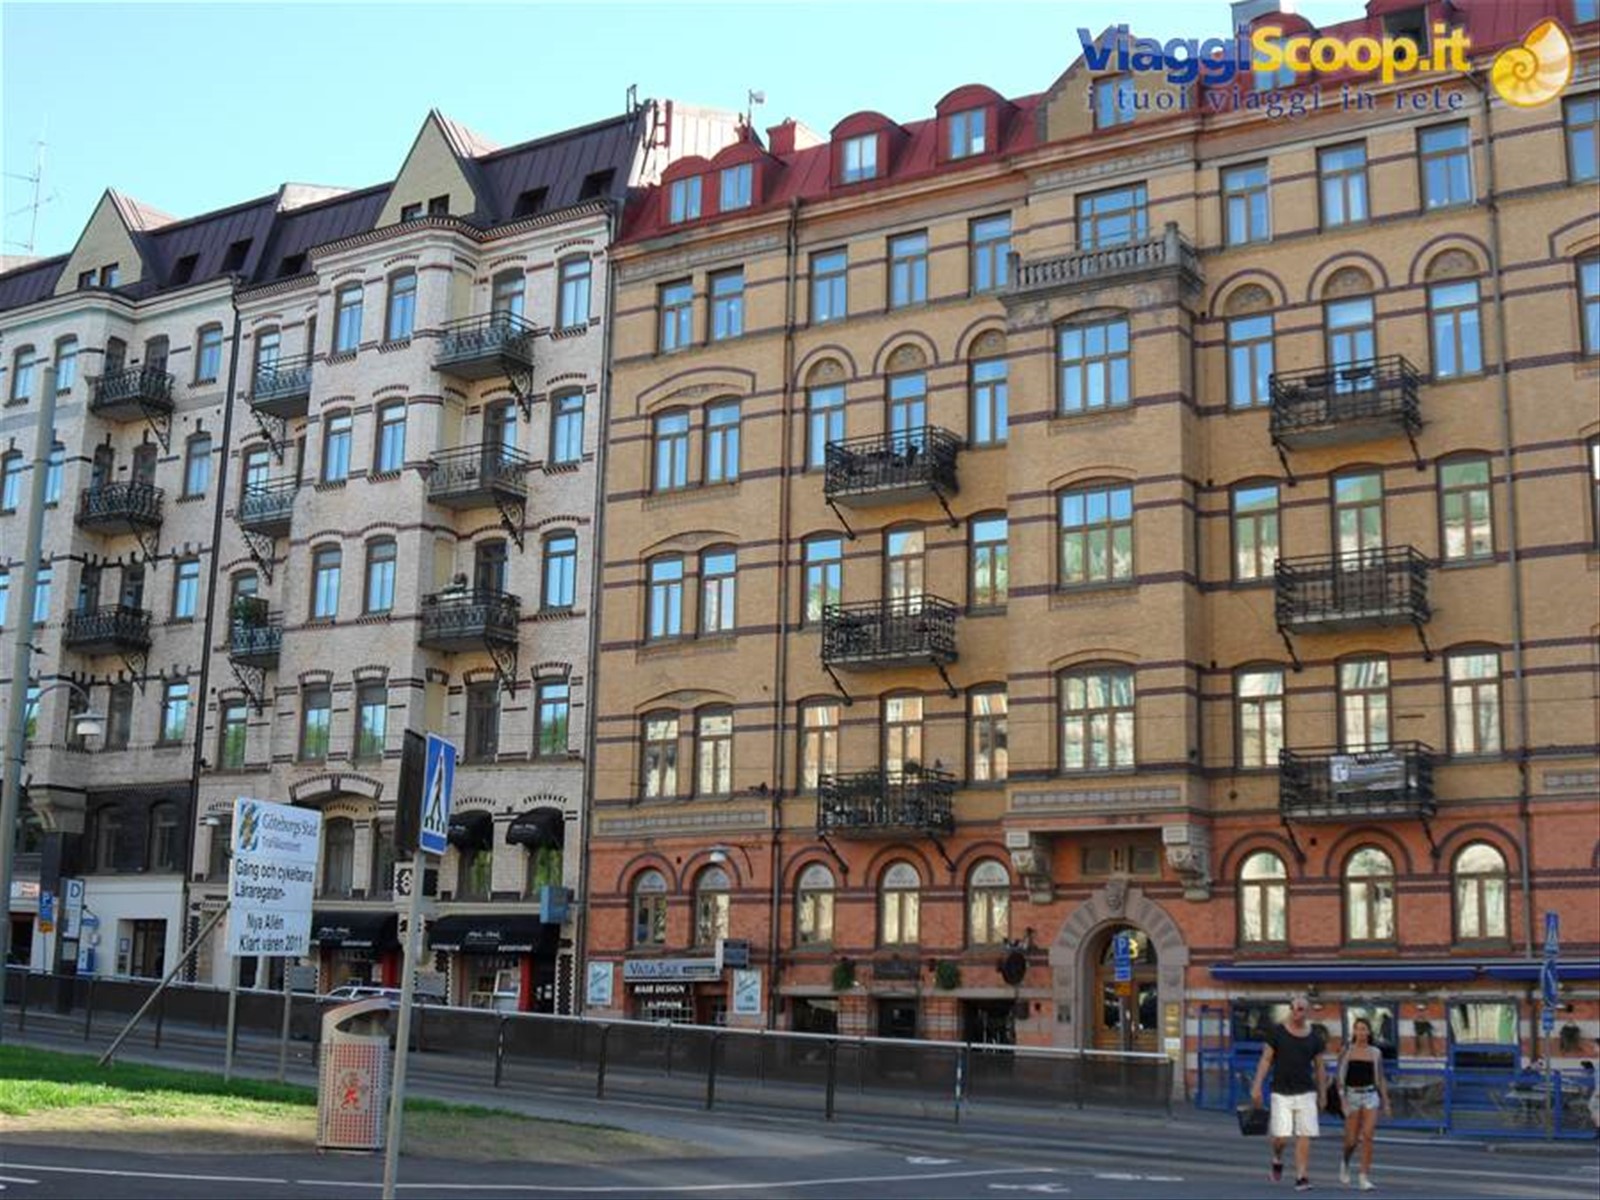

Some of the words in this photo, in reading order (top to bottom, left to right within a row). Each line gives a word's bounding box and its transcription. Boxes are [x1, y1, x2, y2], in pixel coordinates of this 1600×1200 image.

[235, 858, 259, 881] Gång
[260, 863, 277, 879] och
[285, 934, 303, 951] 2011
